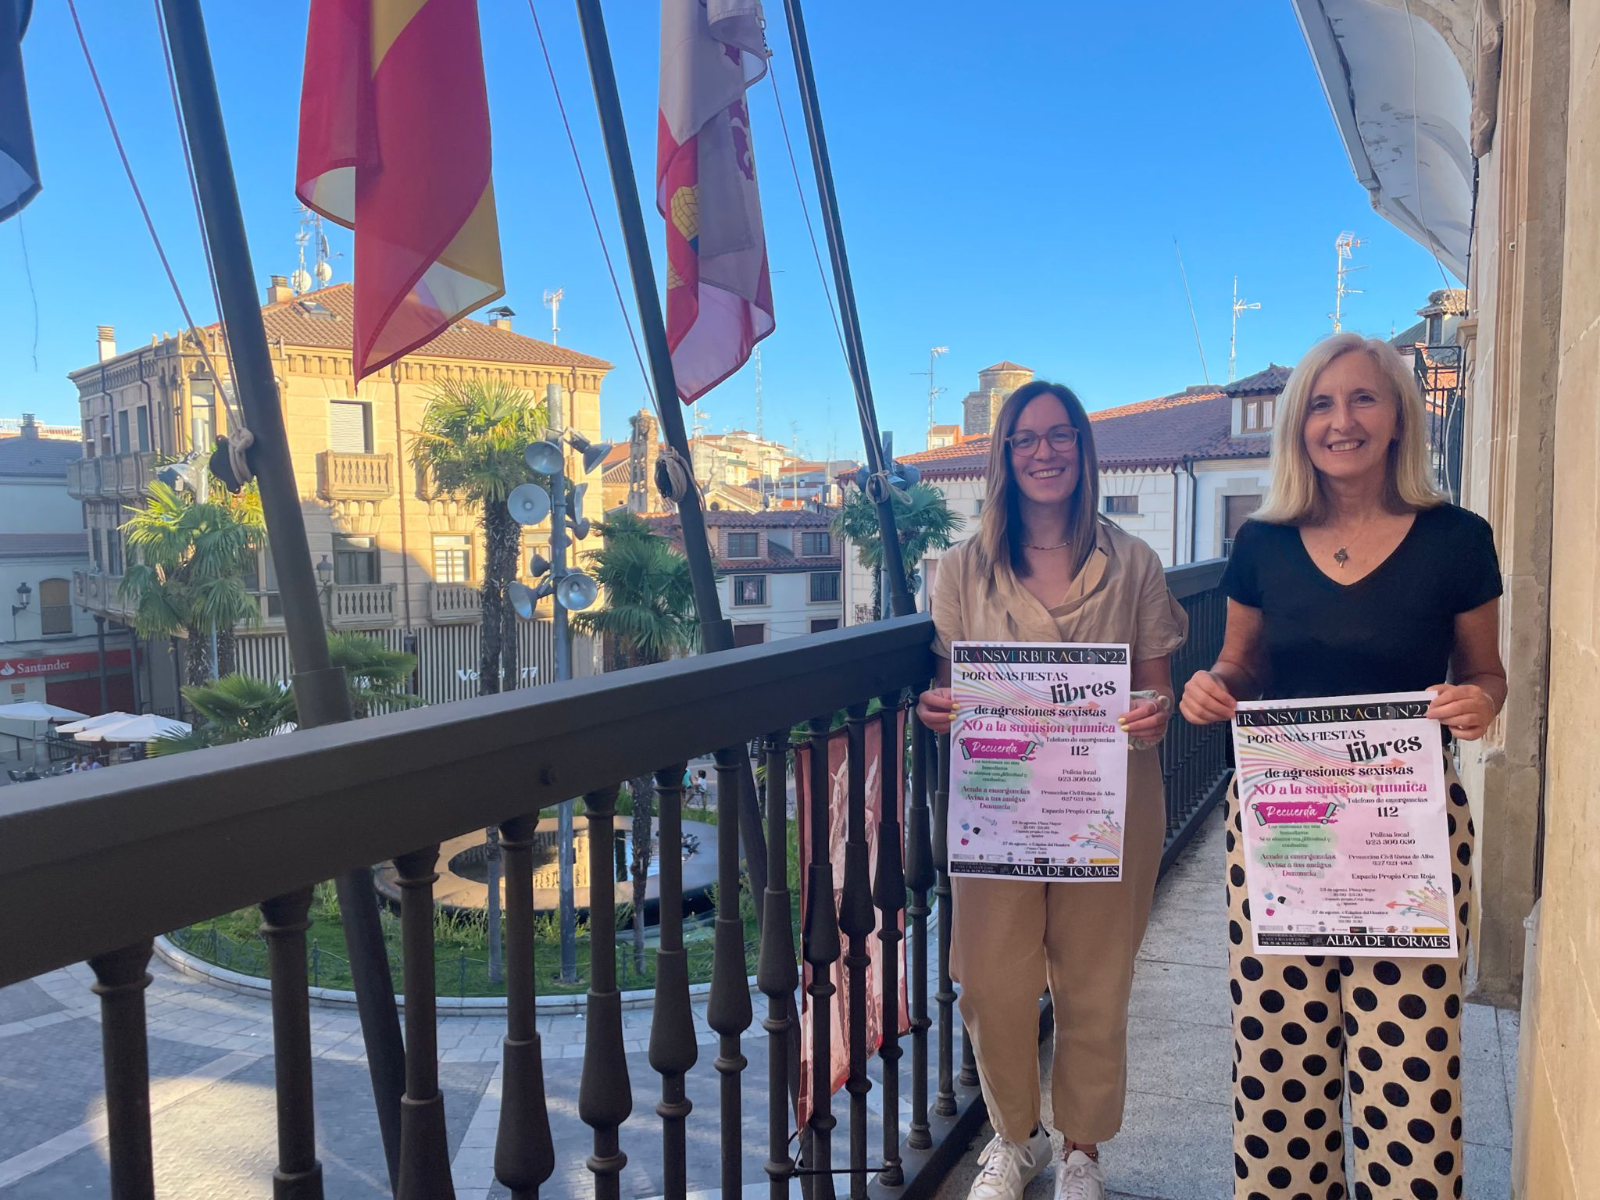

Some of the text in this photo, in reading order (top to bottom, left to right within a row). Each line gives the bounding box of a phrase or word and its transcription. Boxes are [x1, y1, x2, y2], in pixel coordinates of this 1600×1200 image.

[17, 659, 71, 674] Santander
[521, 666, 538, 679] 77
[962, 671, 1068, 682] POR UNAS FIESTAS
[1050, 680, 1116, 704] libres
[974, 705, 1107, 718] de agresiones sexistas
[962, 720, 983, 731] NO
[985, 723, 994, 731] a
[995, 720, 1006, 732] la
[1247, 729, 1366, 744] POR UNAS FIESTAS
[971, 741, 1018, 754] Recuerda
[1070, 745, 1090, 756] 112
[1345, 735, 1422, 763] libres
[1264, 764, 1414, 780] de agresiones sexistas
[1253, 784, 1276, 796] NO
[1279, 785, 1288, 795] a
[1290, 782, 1302, 795] la
[1266, 804, 1318, 819] Recuerda
[1377, 806, 1399, 818] 112
[1012, 865, 1119, 877] ALBA DE TORMES
[1326, 935, 1450, 947] ALBA DE TORMES
